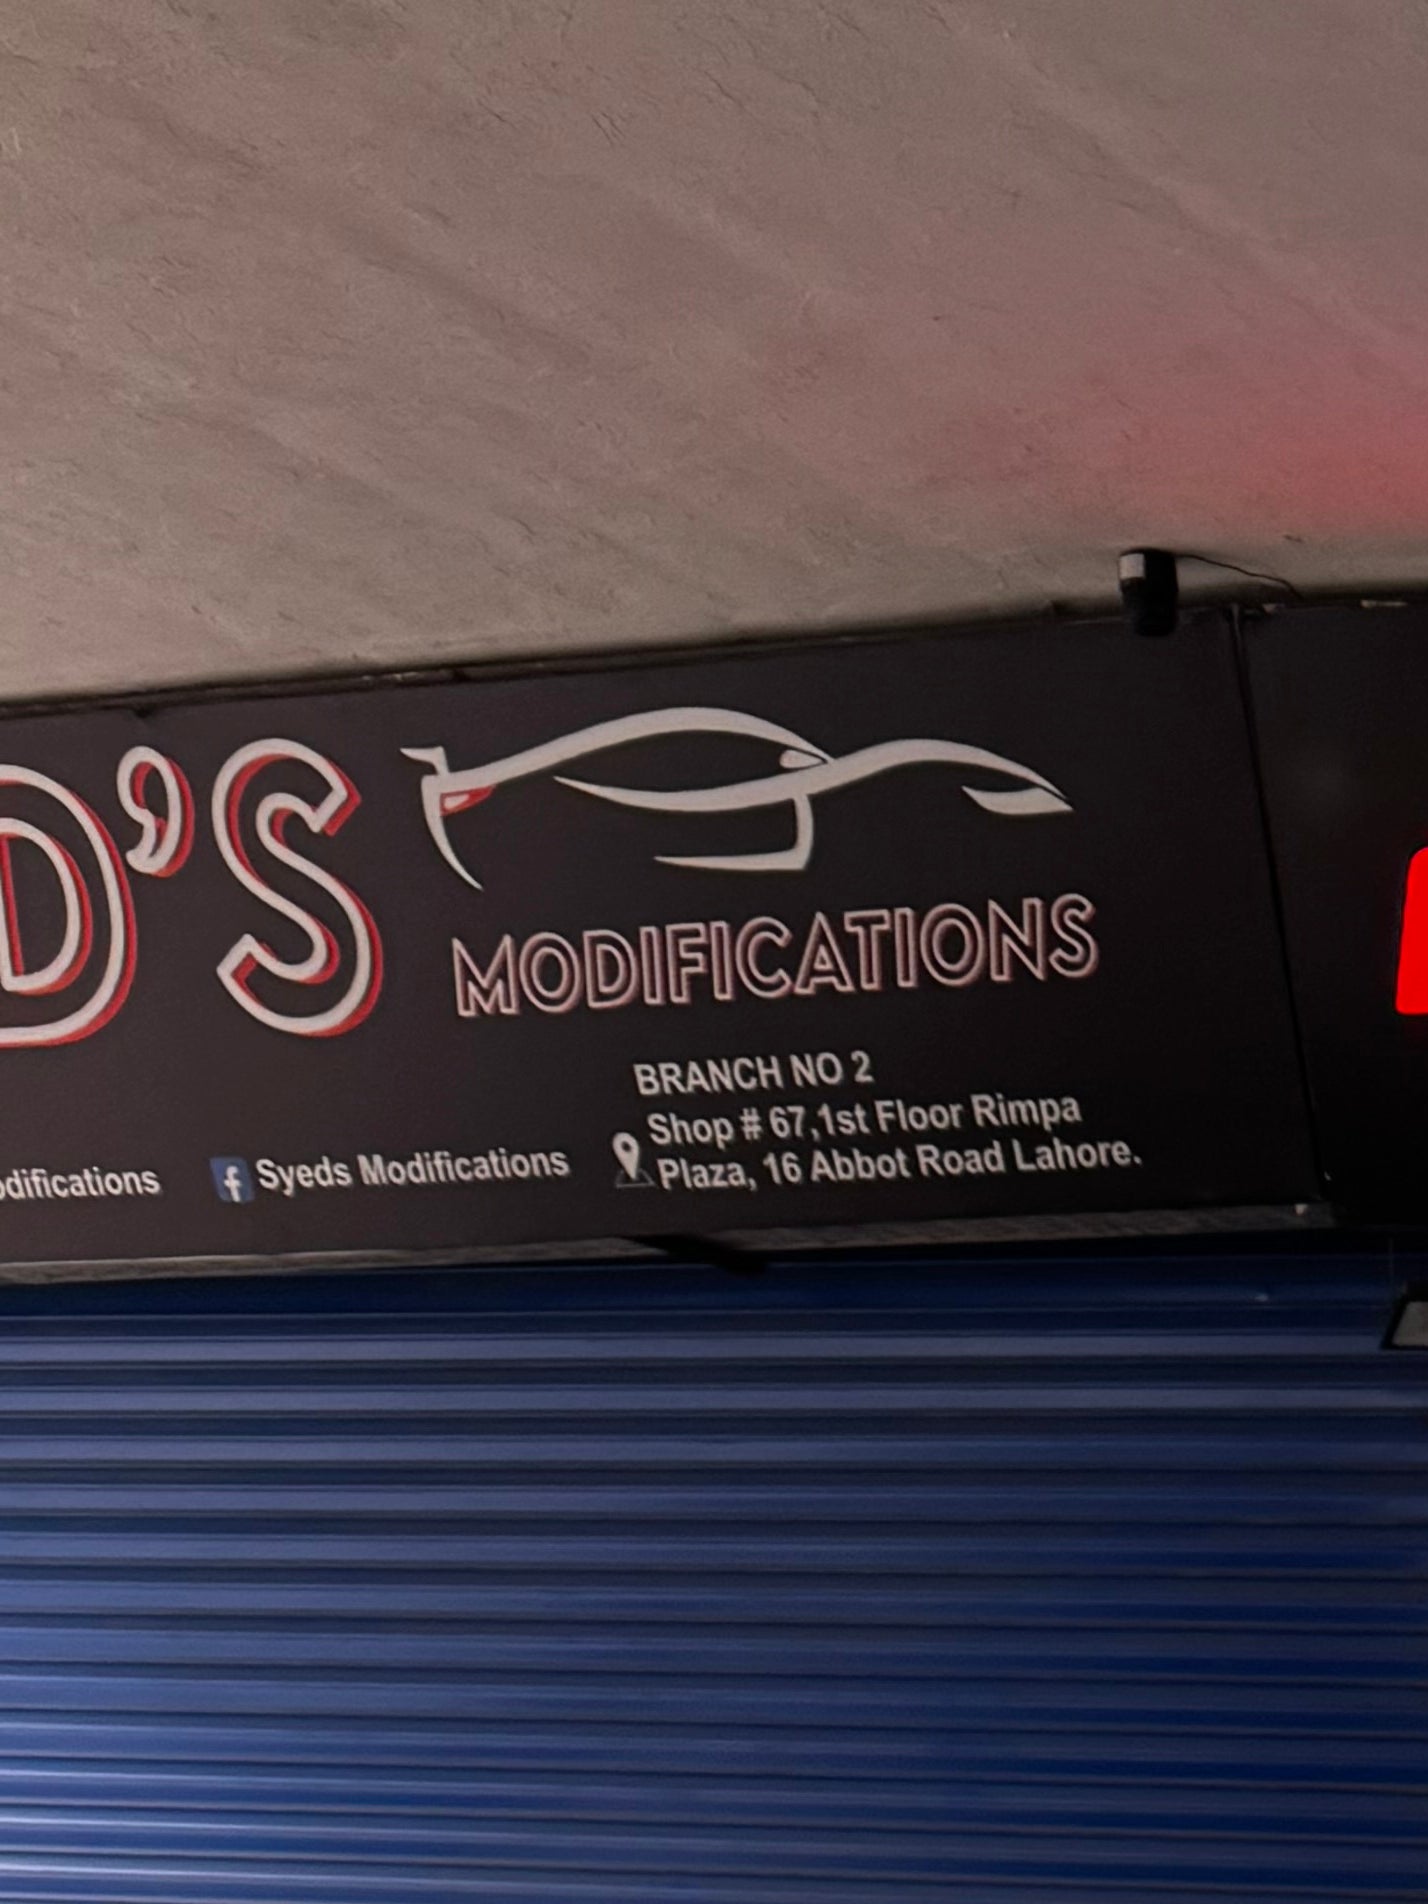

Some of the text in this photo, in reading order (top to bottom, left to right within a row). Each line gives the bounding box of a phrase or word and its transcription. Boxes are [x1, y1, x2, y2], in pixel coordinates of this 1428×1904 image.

[451, 891, 1101, 1018] MODIFICATIONS
[634, 1050, 875, 1096] BRANCH NO 2
[648, 1112, 733, 1149] Shop
[741, 1108, 763, 1140] #
[876, 1098, 962, 1132] Floor
[971, 1093, 1082, 1132] Rimpa
[0, 1166, 162, 1200] difications
[256, 1145, 570, 1197] Syeds Modifications
[658, 1137, 1142, 1190] Plaza, 16 Abbot Road Lahore.
